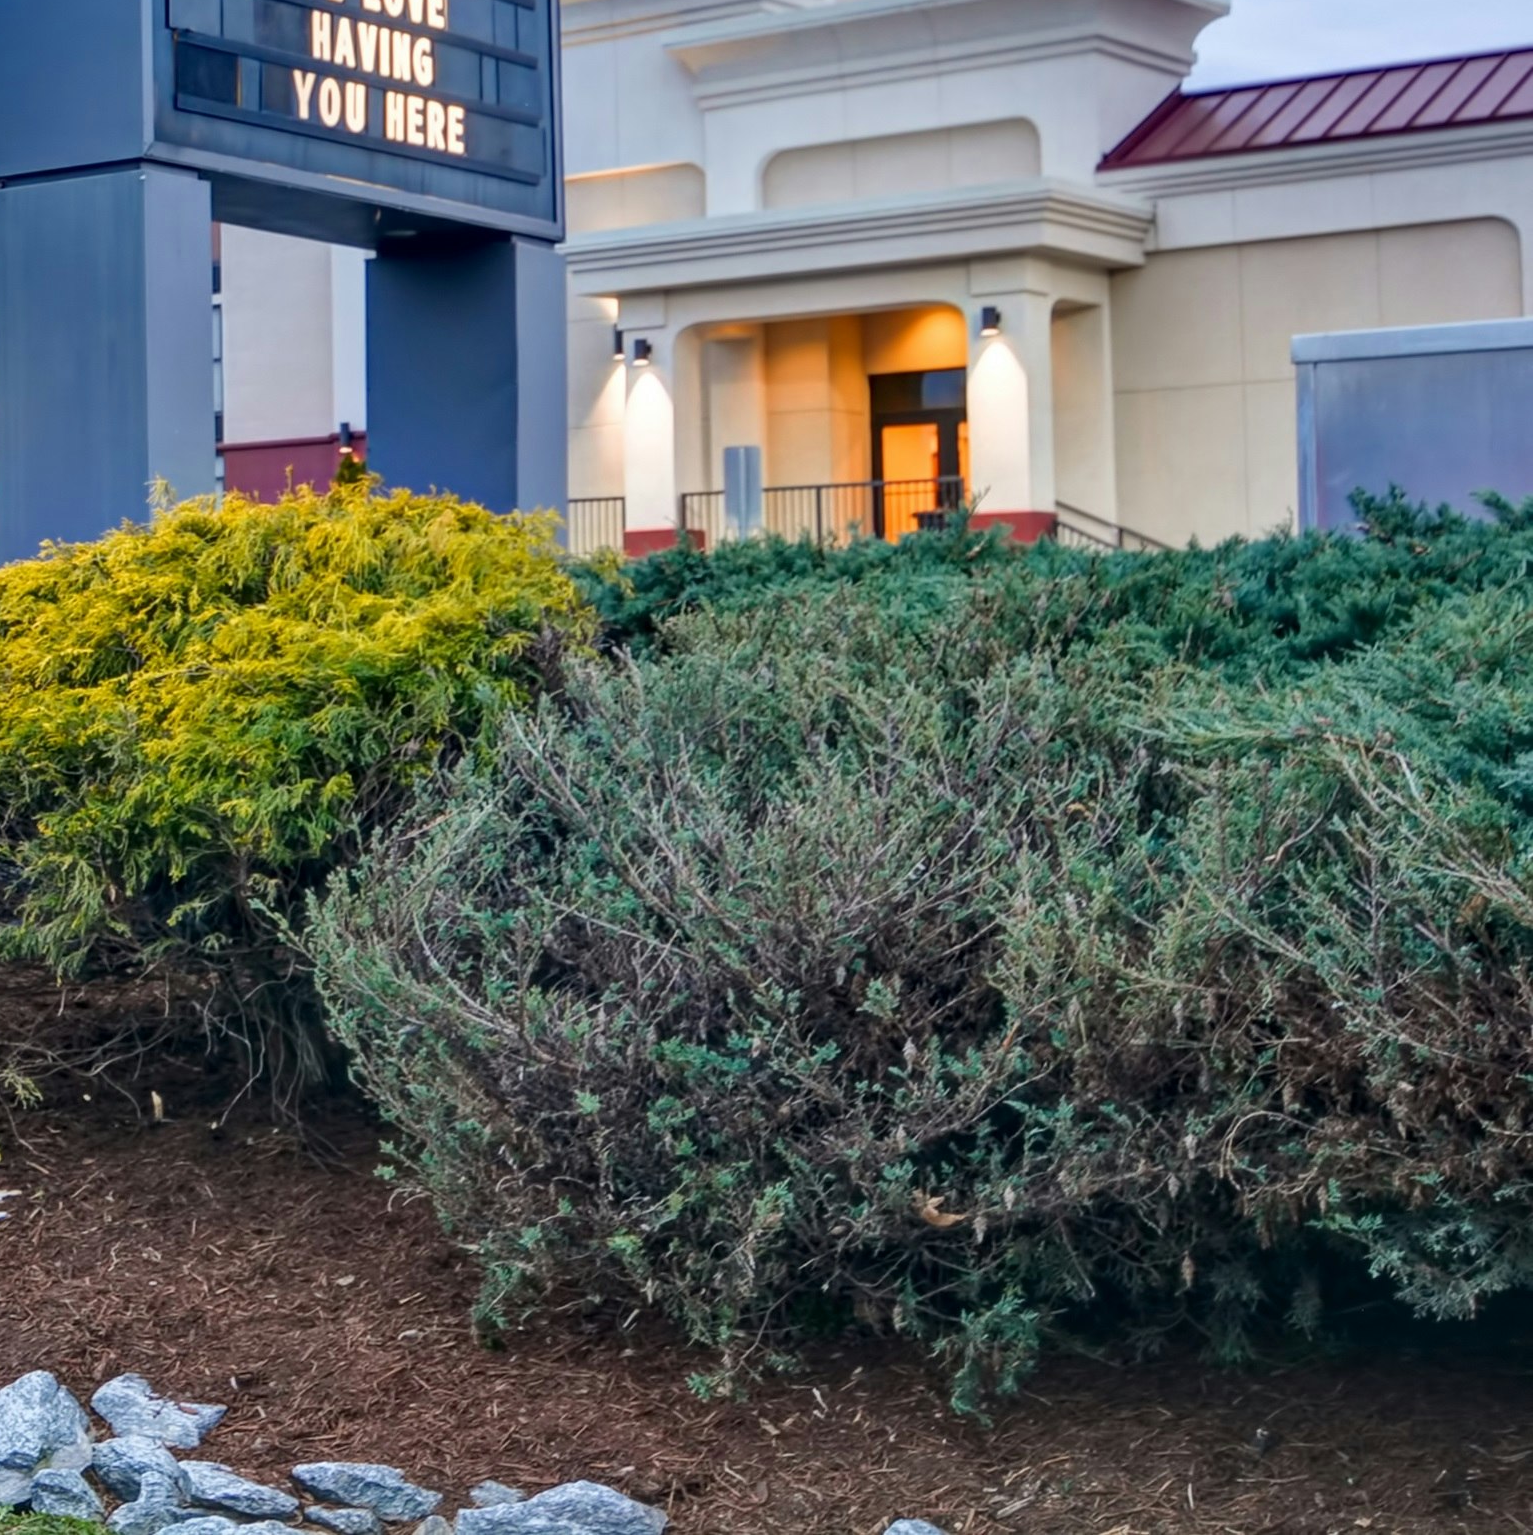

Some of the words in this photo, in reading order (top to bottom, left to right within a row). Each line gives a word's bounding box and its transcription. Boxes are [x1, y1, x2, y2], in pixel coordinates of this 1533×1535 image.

[311, 11, 435, 88] HAVING
[293, 70, 367, 134] YOU
[383, 89, 466, 156] HERE
